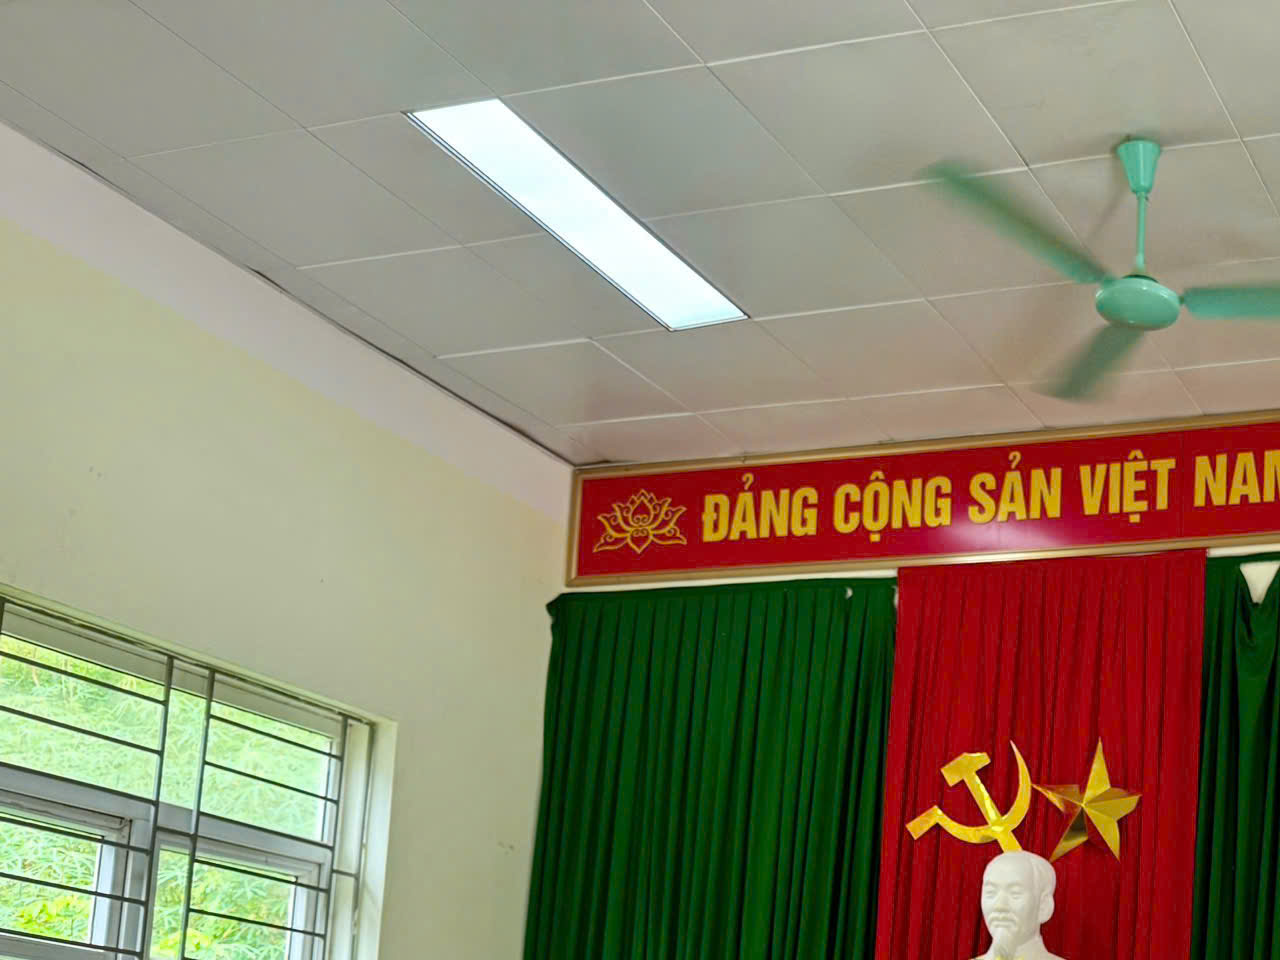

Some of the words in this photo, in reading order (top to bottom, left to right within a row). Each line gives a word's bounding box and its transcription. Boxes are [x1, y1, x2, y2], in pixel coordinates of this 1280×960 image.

[702, 473, 819, 543] ĐẢNG
[832, 470, 953, 545] CỘNG
[966, 451, 1063, 525] SẢN
[1078, 449, 1176, 523] VIỆT
